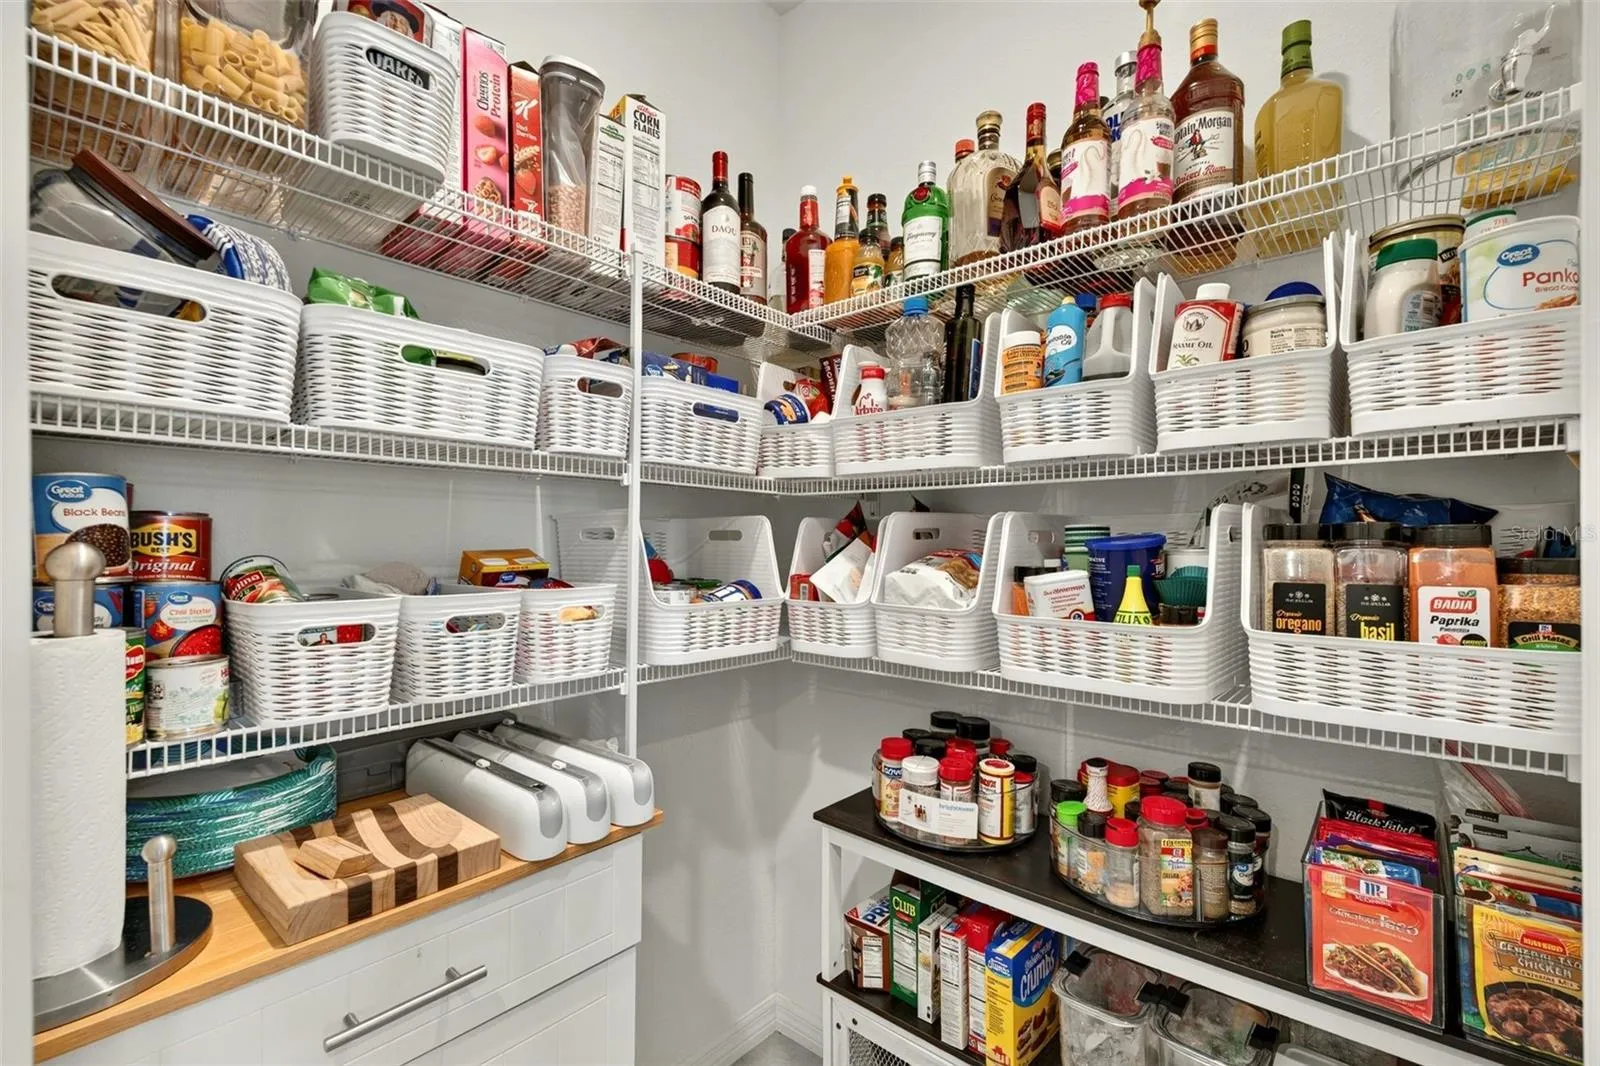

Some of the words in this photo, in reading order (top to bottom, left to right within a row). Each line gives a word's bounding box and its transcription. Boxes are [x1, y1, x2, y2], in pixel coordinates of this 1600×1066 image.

[490, 73, 501, 119] Protein
[633, 109, 660, 131] CORN
[1198, 116, 1233, 130] Morgan
[633, 119, 660, 140] FLAKES
[1501, 248, 1533, 262] Great
[1522, 267, 1580, 287] Panko
[1535, 286, 1560, 294] Bread
[50, 484, 85, 496] Great
[63, 507, 99, 517] Black
[101, 507, 127, 517] Beans
[130, 531, 193, 549] BUSH'S
[127, 558, 196, 575] Original
[1433, 599, 1473, 610] BADIA
[1275, 617, 1322, 635] oregano
[1429, 615, 1480, 628] Paprika
[1360, 621, 1395, 641] basil
[1520, 634, 1541, 644] Grill
[1344, 809, 1381, 828] Black
[1381, 819, 1417, 835] Label
[892, 896, 917, 917] CLUB
[1020, 949, 1055, 1003] Crumbs
[1518, 957, 1573, 979] CHICKEN
